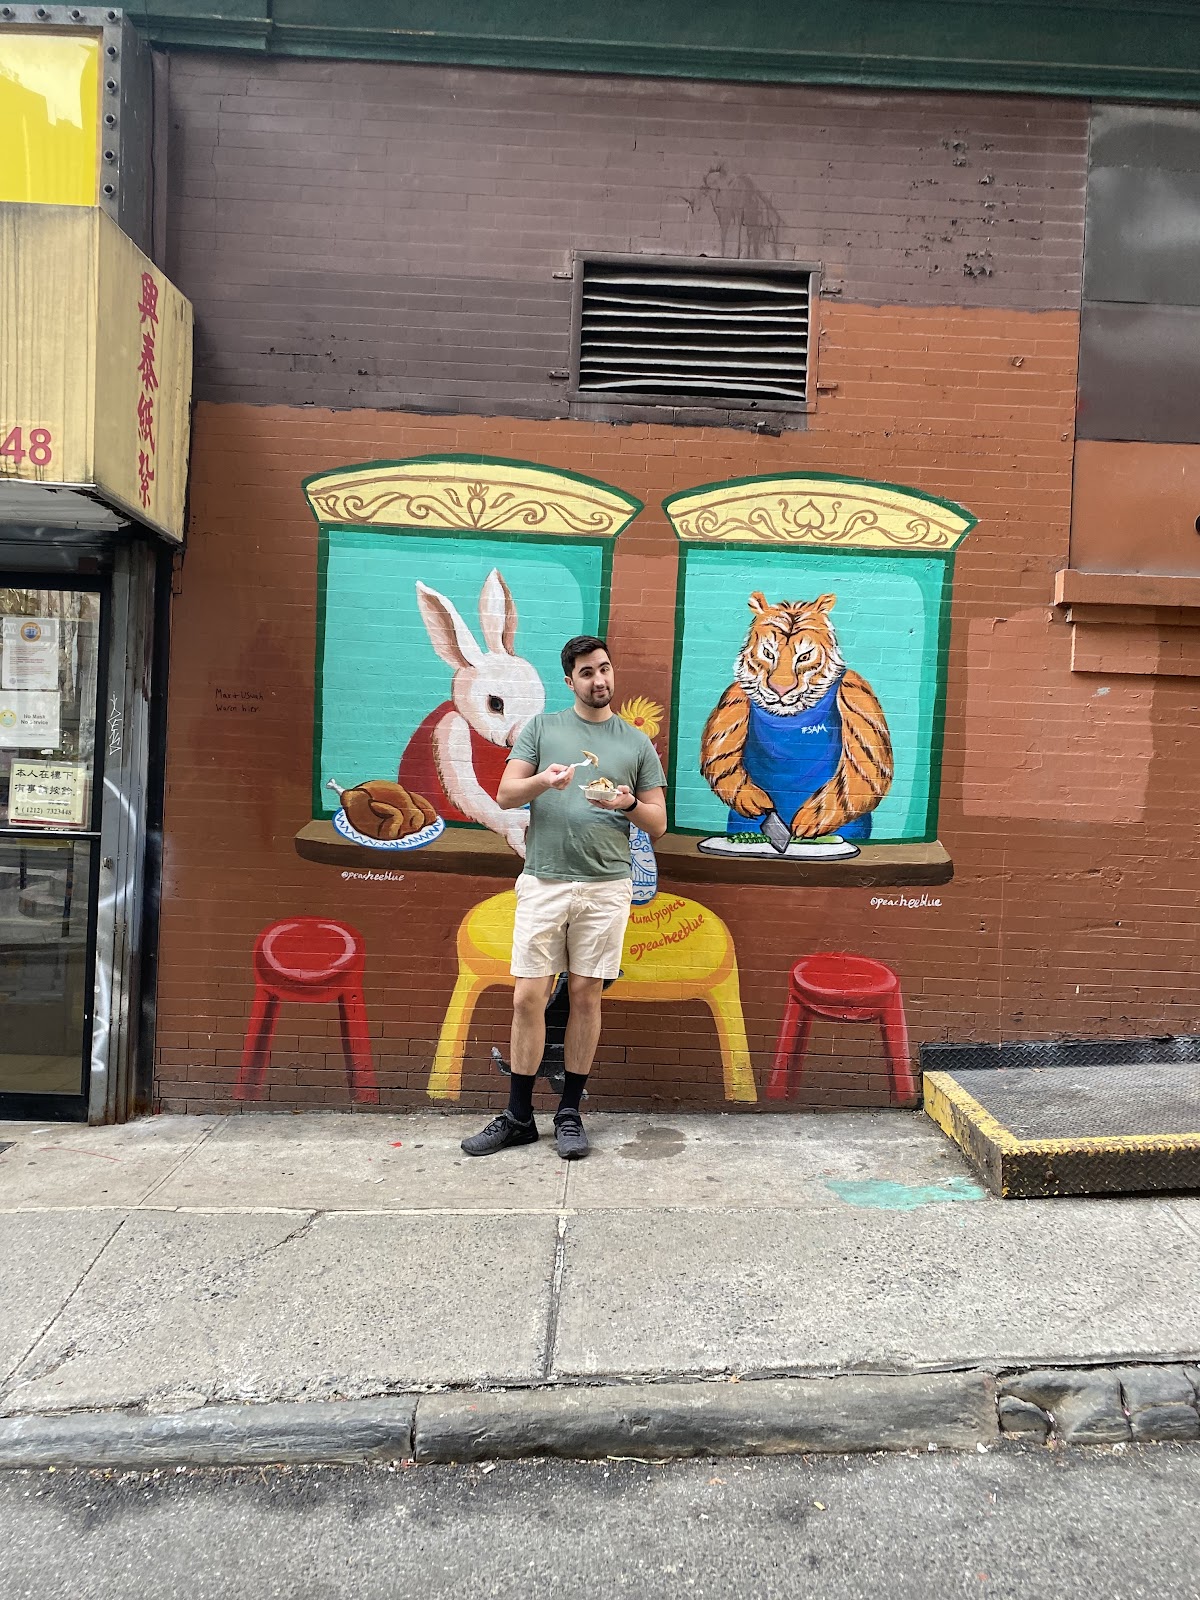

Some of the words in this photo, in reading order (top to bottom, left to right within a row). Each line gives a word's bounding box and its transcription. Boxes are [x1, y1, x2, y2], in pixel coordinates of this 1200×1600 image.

[0, 426, 52, 465] 48
[800, 723, 828, 734] #SAM
[341, 870, 405, 881] @peacheeblue
[870, 893, 943, 910] @peacheeblue
[629, 913, 705, 961] @peacheeblue
